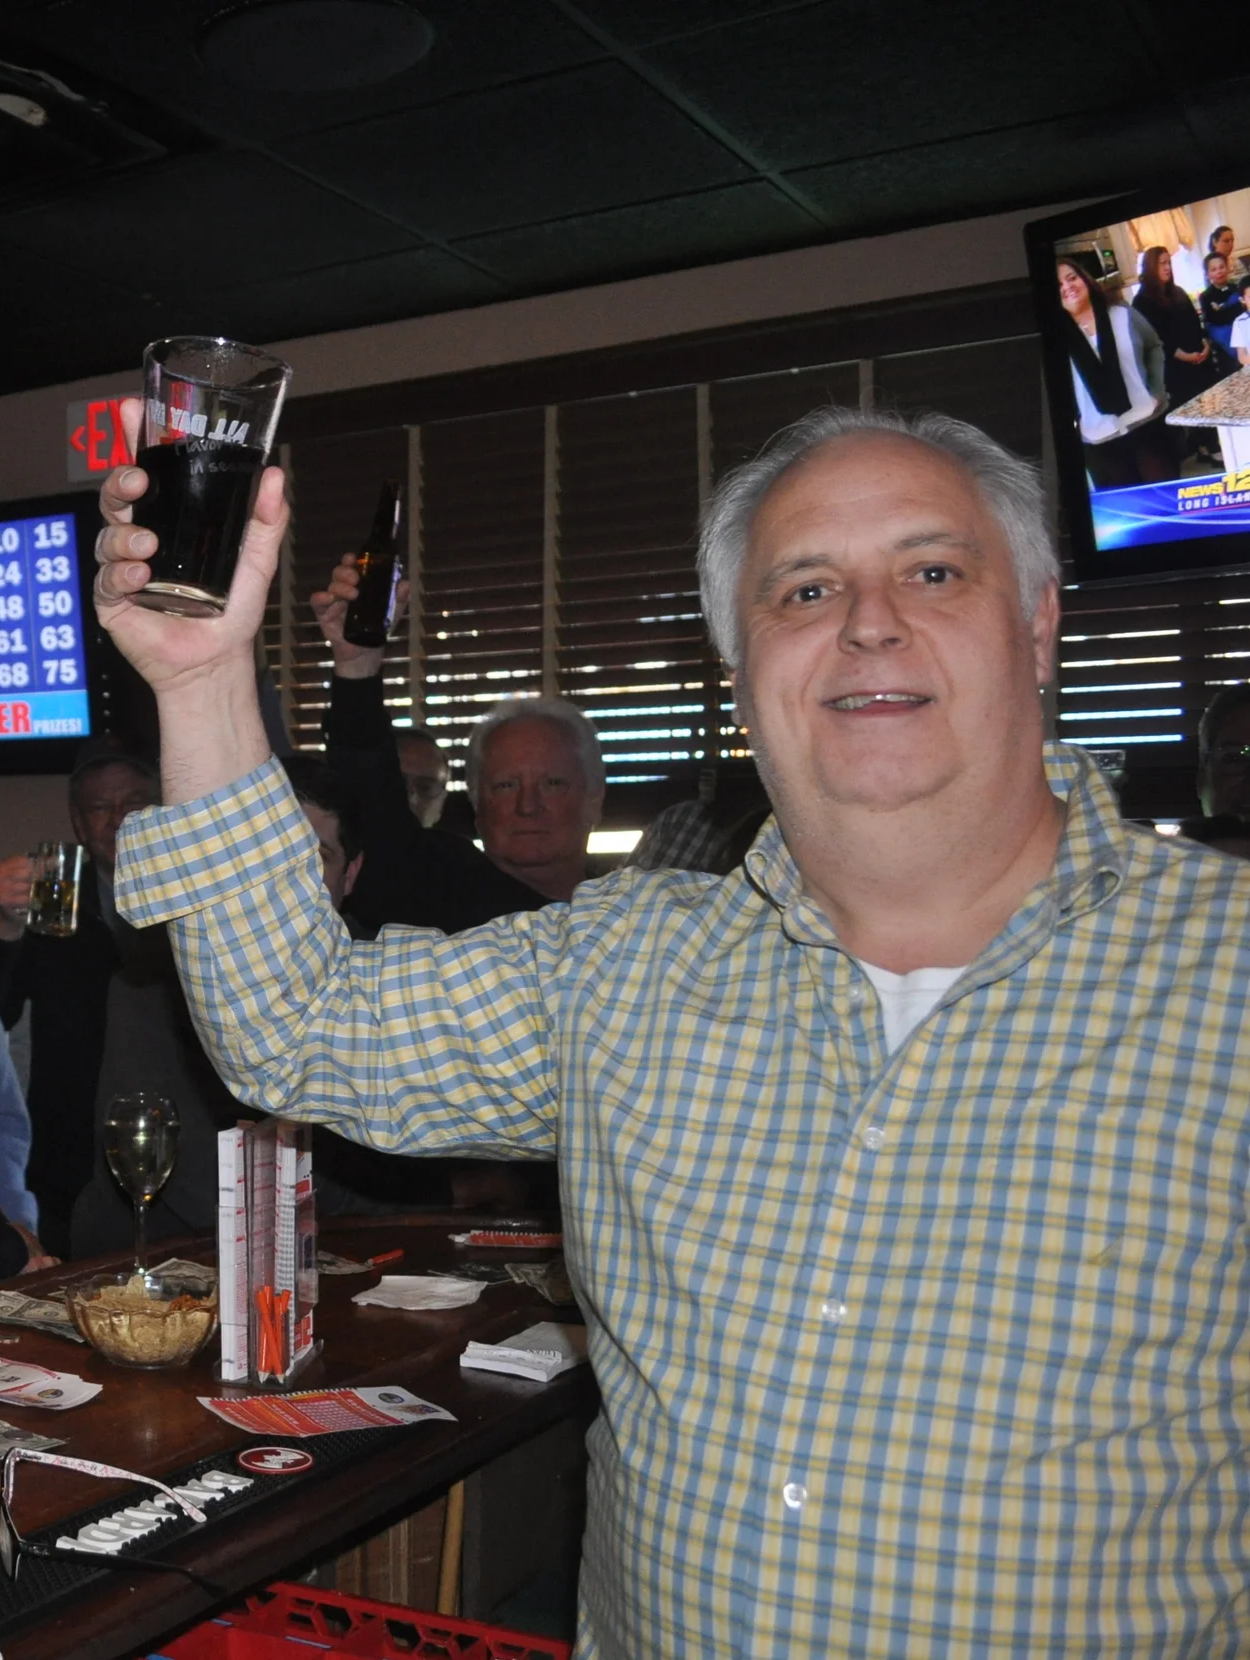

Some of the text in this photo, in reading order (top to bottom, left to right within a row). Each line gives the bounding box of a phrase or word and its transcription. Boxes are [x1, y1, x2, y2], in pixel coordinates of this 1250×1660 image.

[86, 396, 137, 472] EX
[1177, 481, 1225, 500] NEWS
[1177, 498, 1210, 511] LONG
[34, 521, 68, 549] 15
[35, 555, 71, 584] 33
[38, 590, 73, 617] 50
[39, 624, 76, 651] 63
[42, 658, 78, 685] 75
